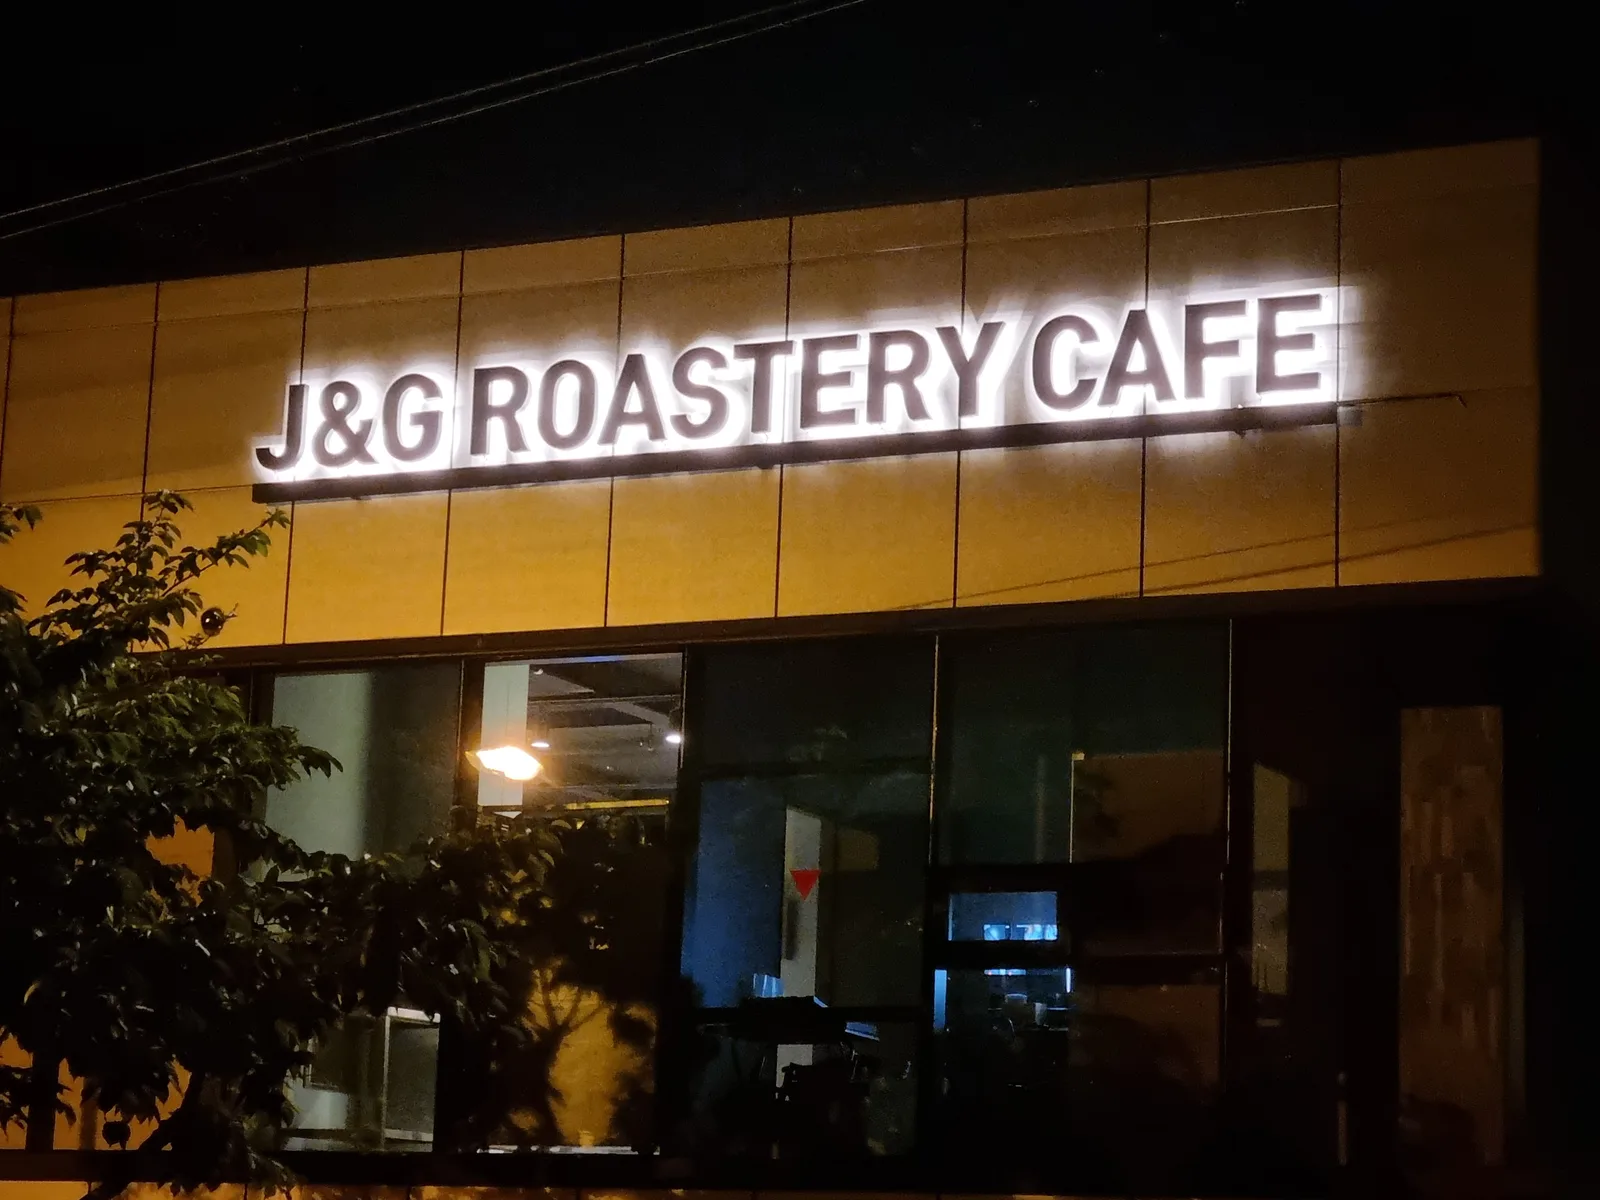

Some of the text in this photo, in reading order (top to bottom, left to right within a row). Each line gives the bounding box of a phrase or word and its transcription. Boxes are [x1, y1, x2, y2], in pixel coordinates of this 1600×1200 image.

[255, 293, 1322, 472] J&G ROASTERY CAFE
